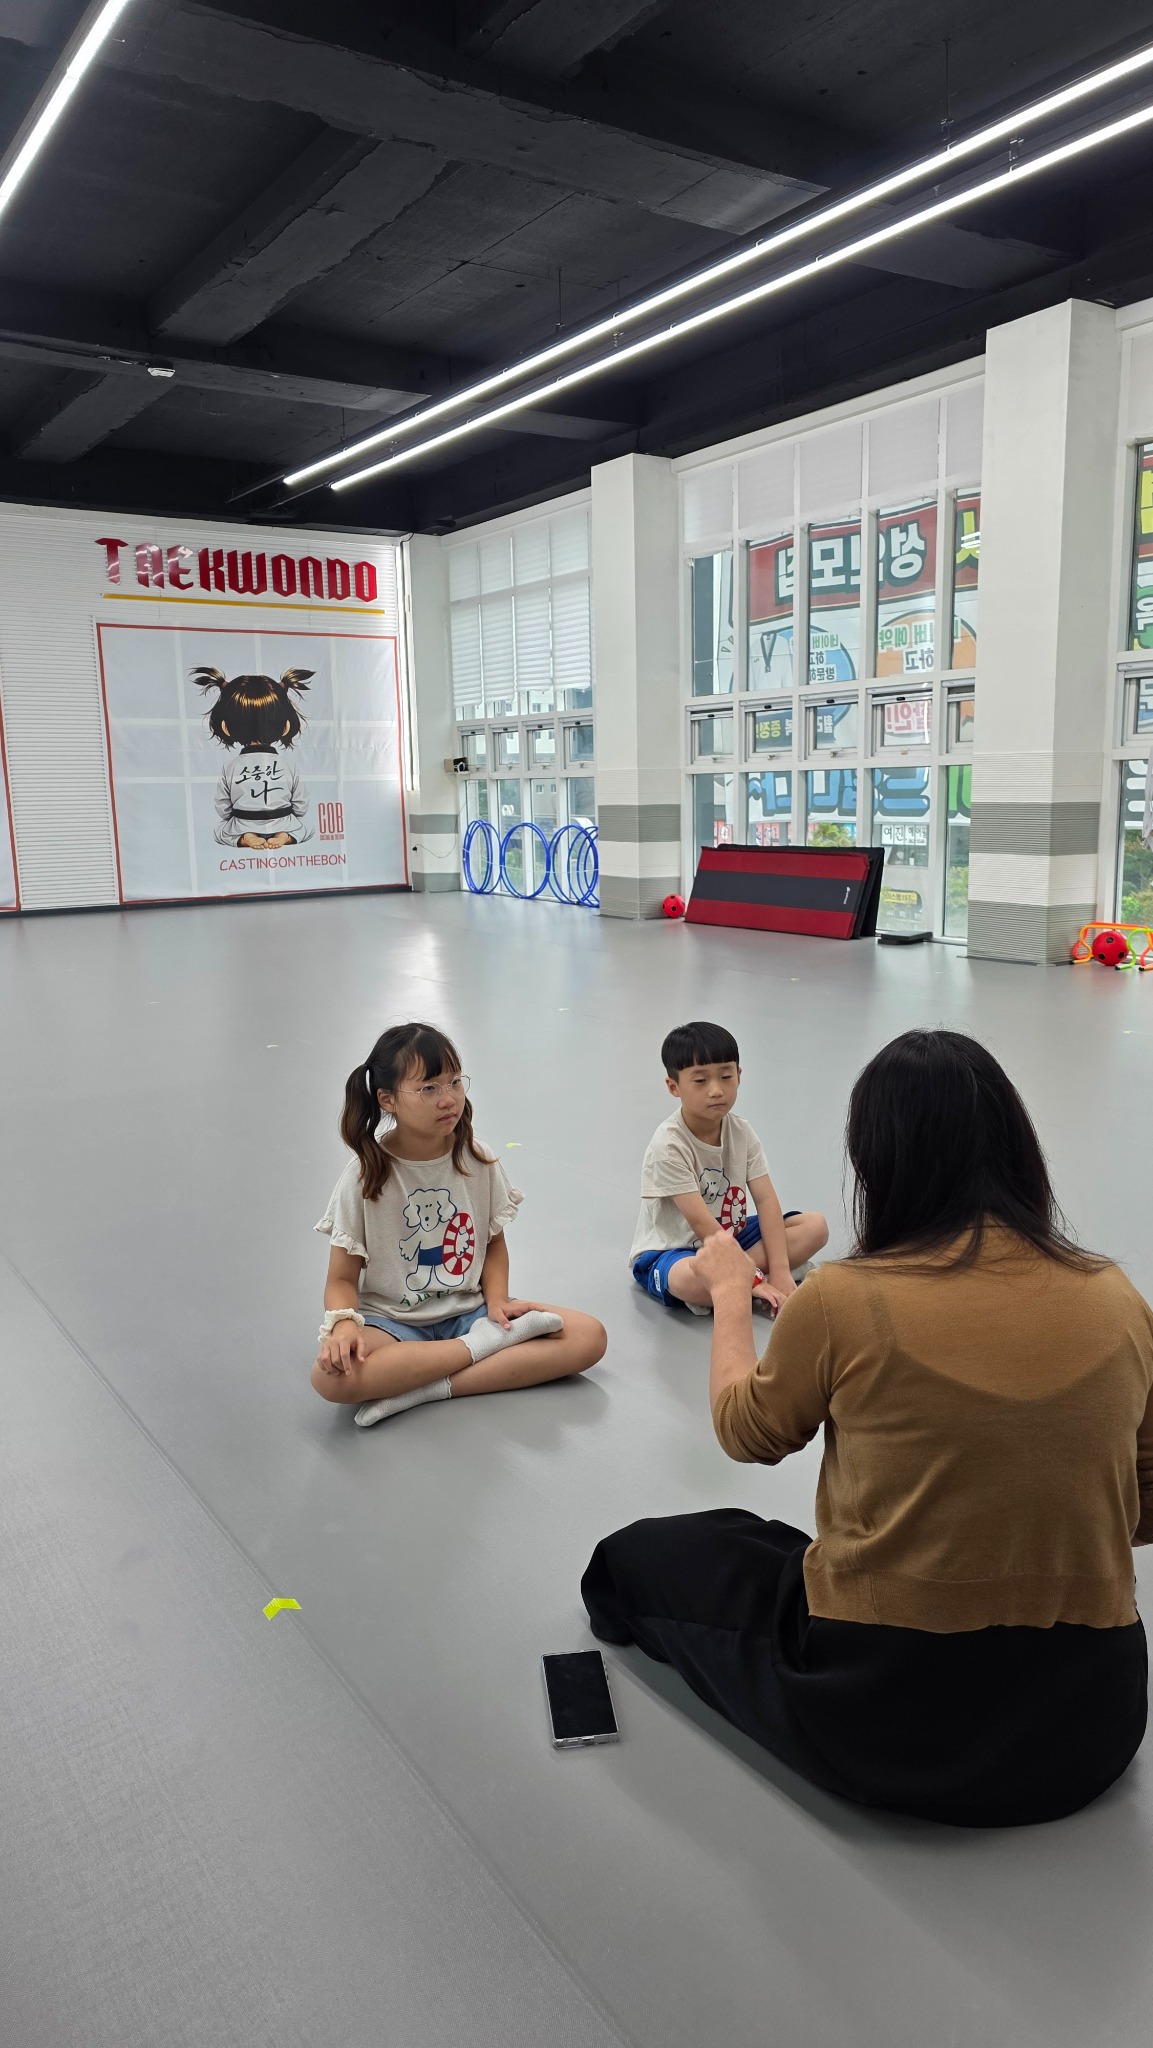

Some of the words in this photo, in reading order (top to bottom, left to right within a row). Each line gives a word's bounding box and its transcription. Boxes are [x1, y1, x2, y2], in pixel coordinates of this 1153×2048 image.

[95, 537, 378, 602] TAEKWONDO
[235, 760, 284, 785] 소중한
[250, 780, 284, 805] 나
[317, 802, 344, 834] COB
[219, 853, 347, 871] CASTINGONTHEBON
